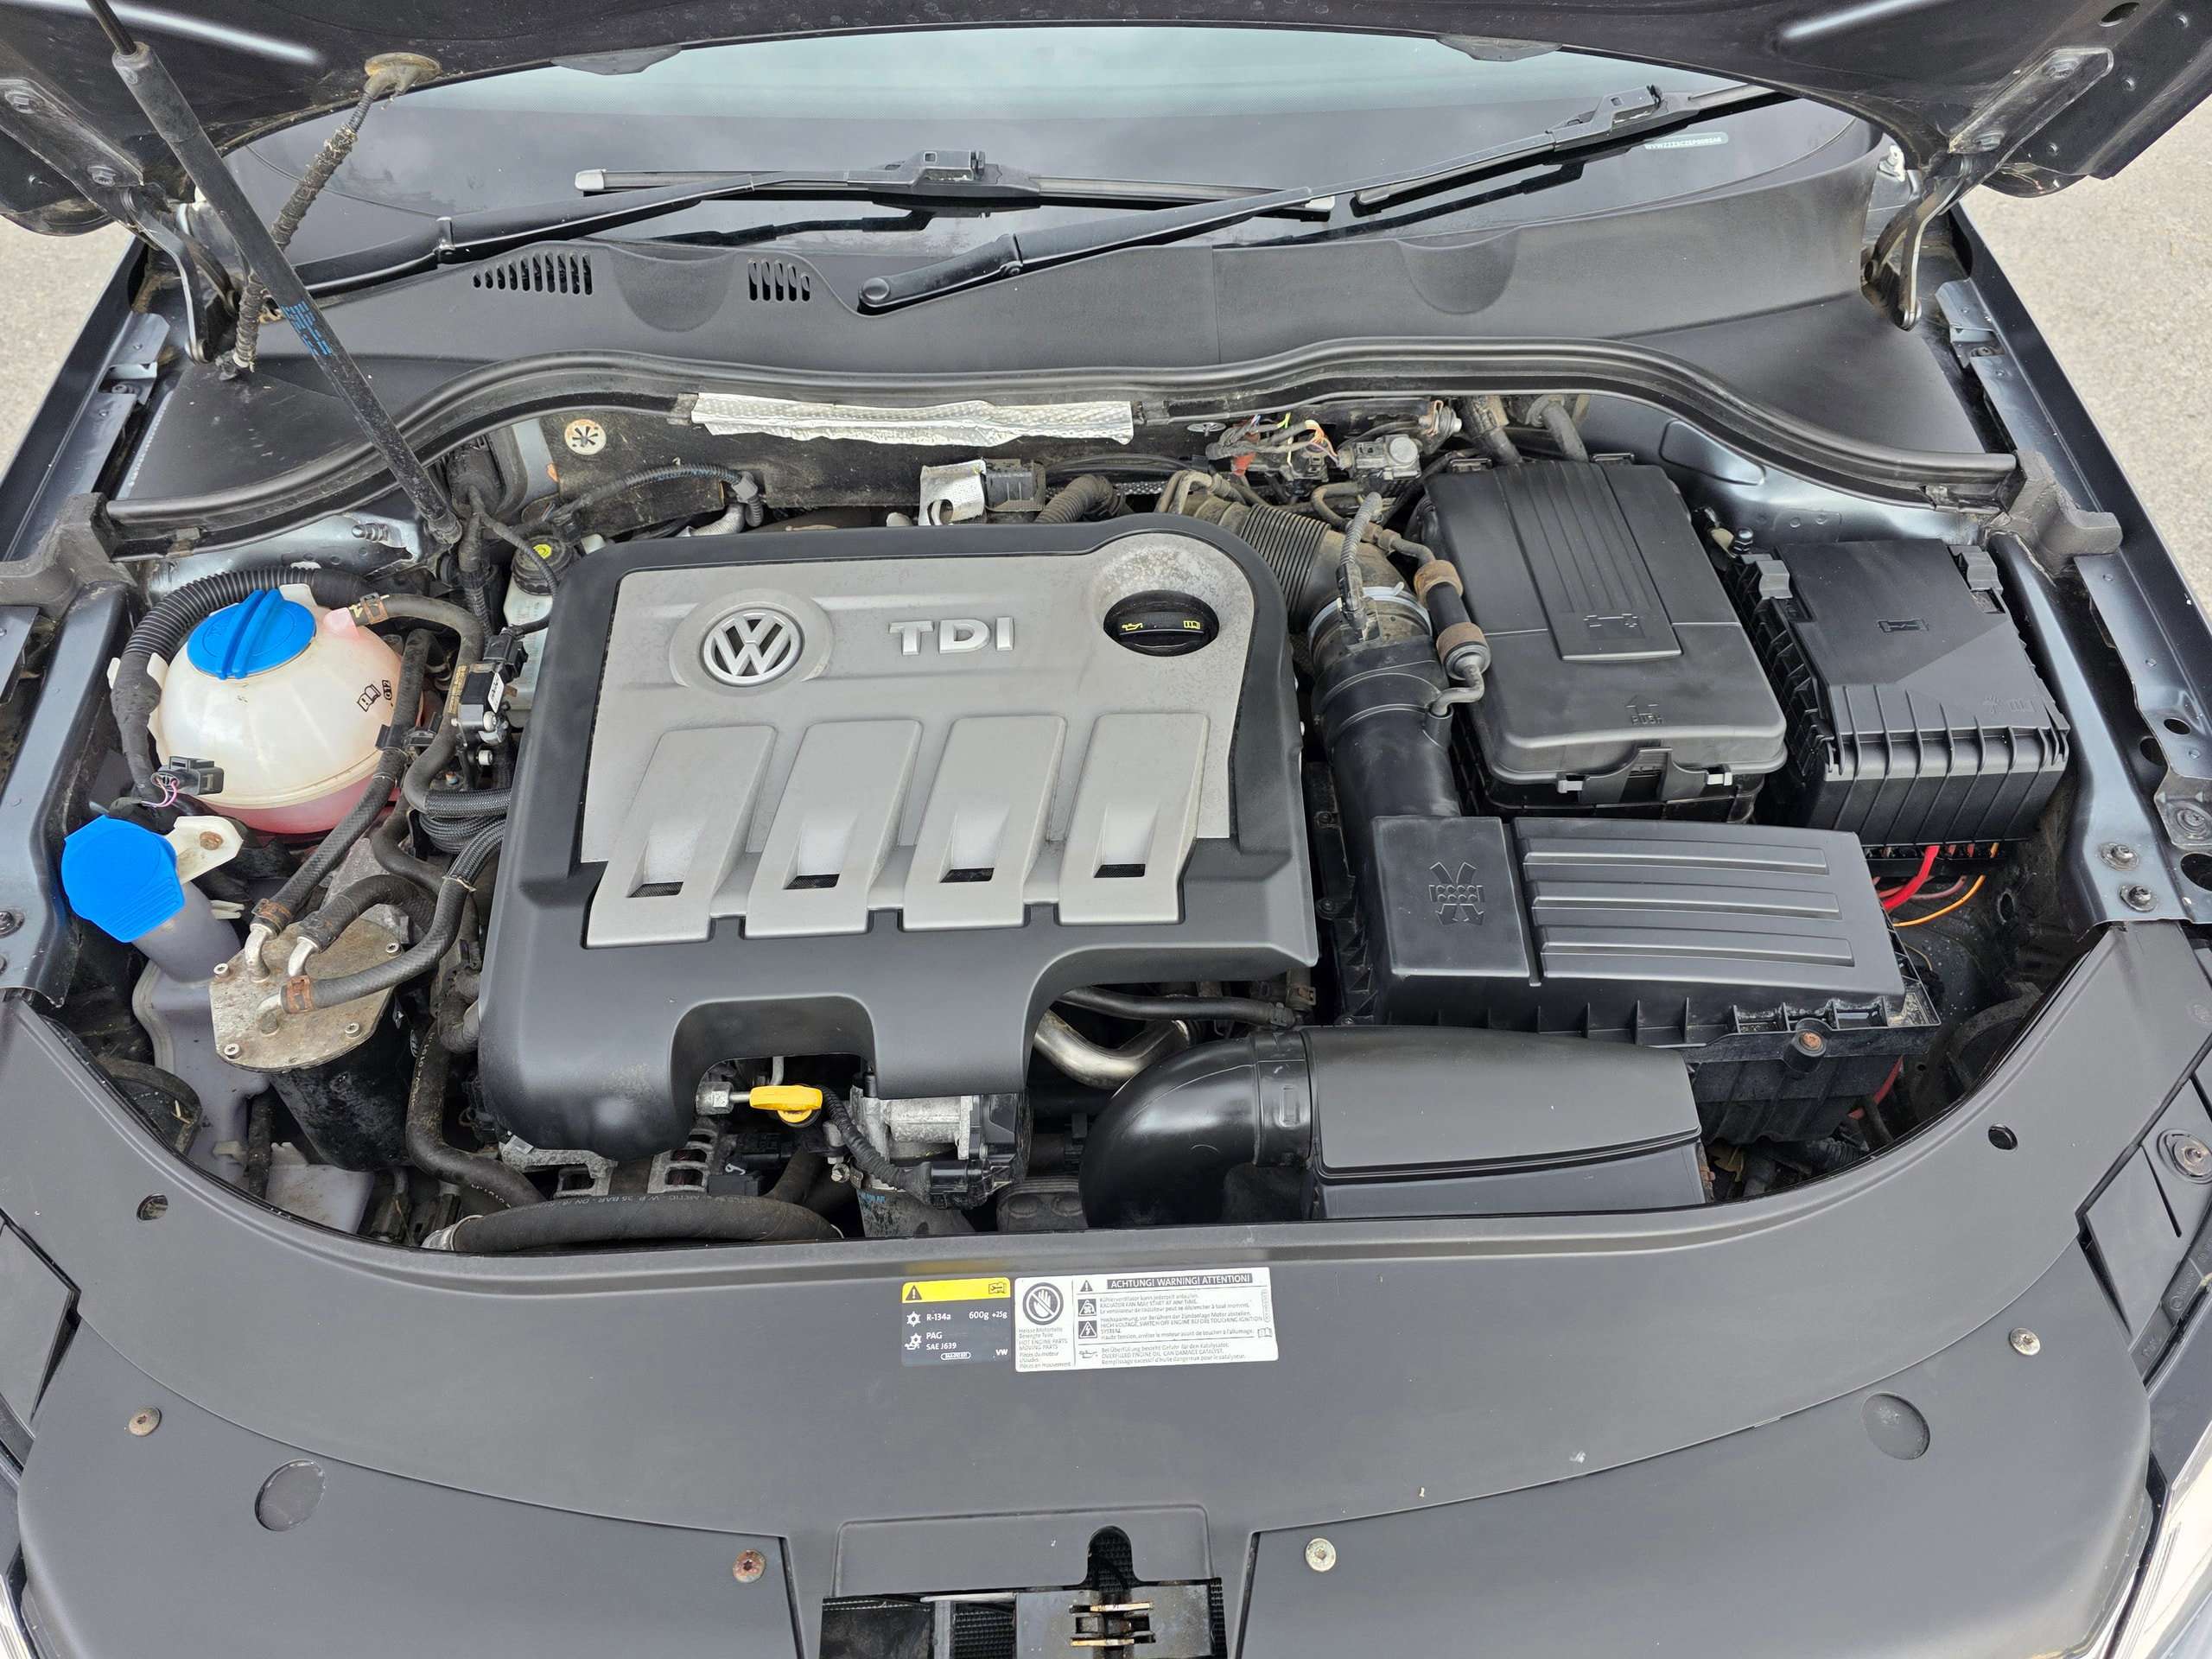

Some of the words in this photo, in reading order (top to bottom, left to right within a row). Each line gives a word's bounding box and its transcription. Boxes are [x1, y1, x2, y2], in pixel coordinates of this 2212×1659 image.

[888, 616, 1014, 655] TDI
[1111, 1279, 1155, 1288] ACHTUNG!
[1157, 1276, 1200, 1287] WARNING!
[1202, 1274, 1250, 1285] ATTENTION!
[926, 1313, 951, 1321] R-134a
[969, 1311, 989, 1320] 600g
